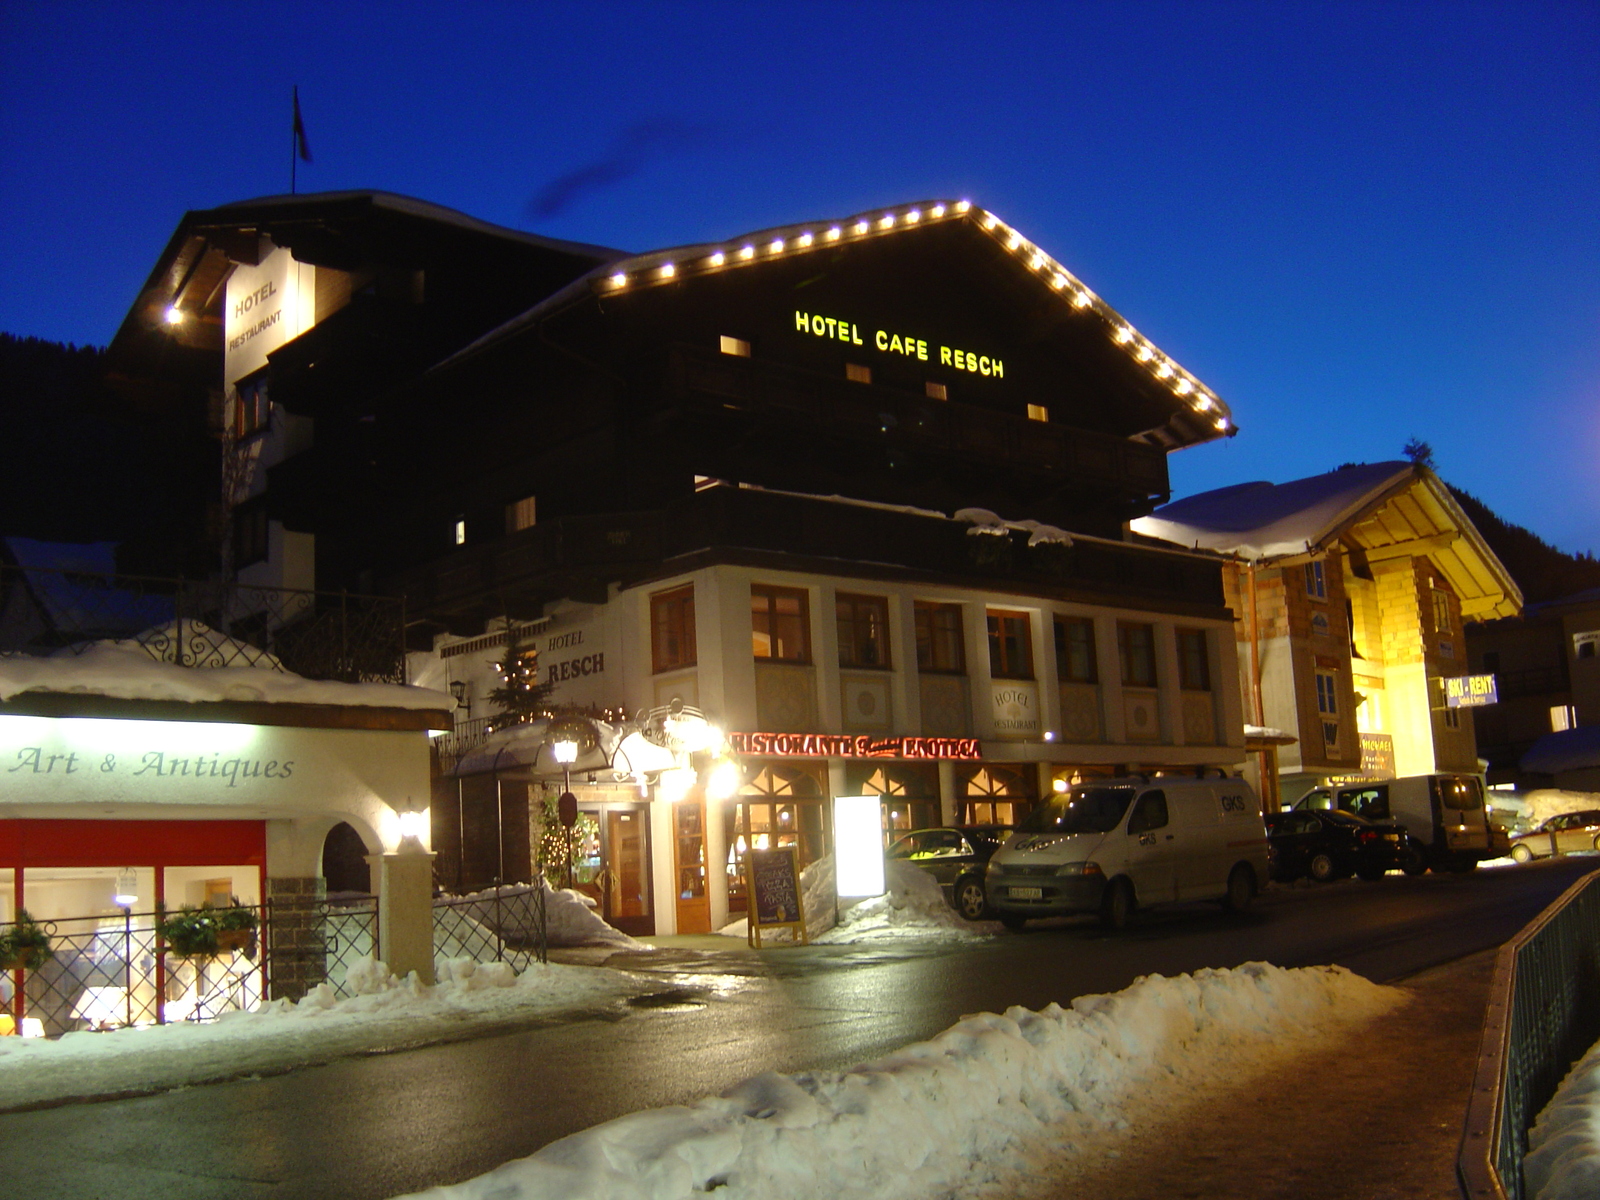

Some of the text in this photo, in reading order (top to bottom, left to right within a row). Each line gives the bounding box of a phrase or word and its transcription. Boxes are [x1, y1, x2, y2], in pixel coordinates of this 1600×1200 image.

[235, 280, 277, 319] HOTEL
[229, 309, 281, 352] RESTAURANT
[795, 310, 1004, 378] HOTEL CAFE RESCH
[548, 630, 584, 651] HOTEL
[548, 652, 604, 685] RESCH
[995, 690, 1029, 709] HOTEL
[728, 731, 852, 758] RISTORANTE
[902, 737, 982, 759] ENOTECA
[8, 747, 294, 788] Art & Antiques
[1221, 795, 1245, 811] GKS
[1139, 833, 1157, 846] GKS
